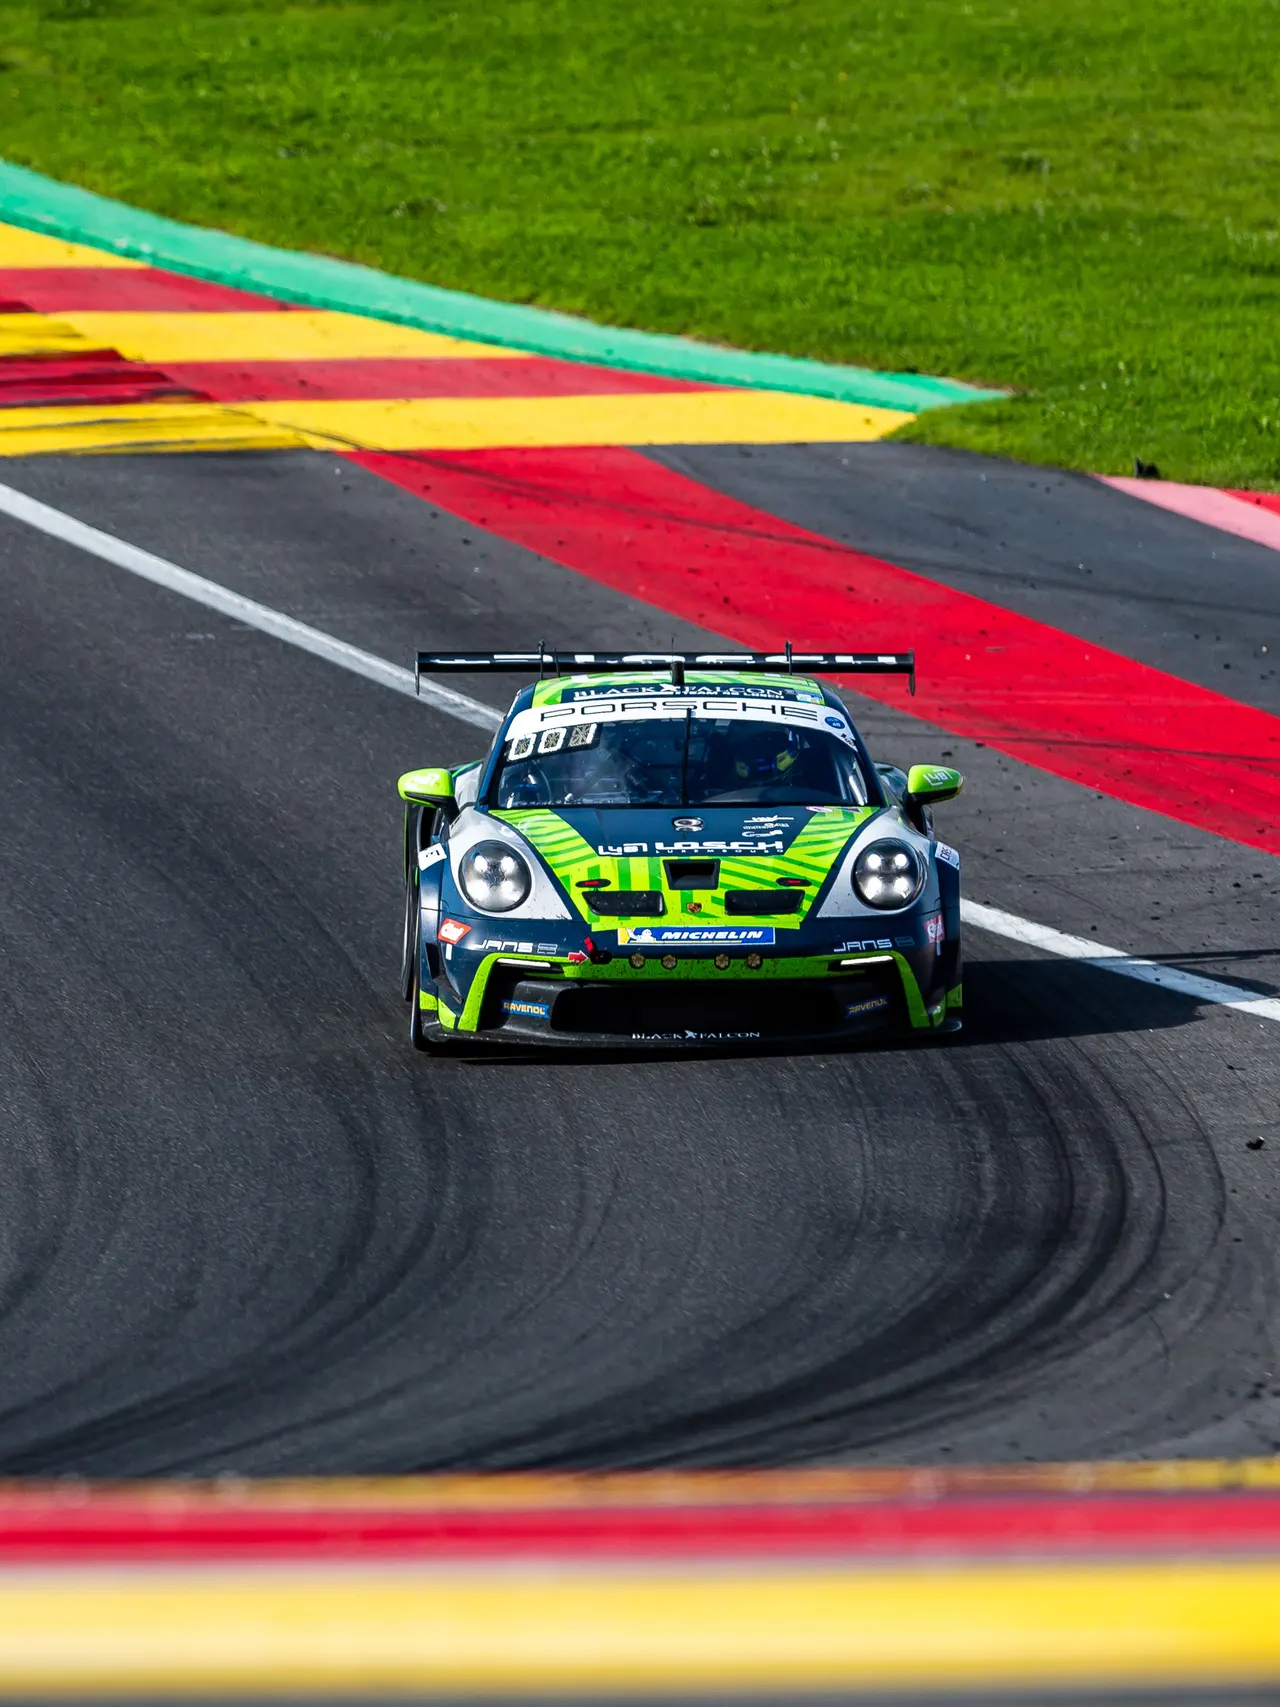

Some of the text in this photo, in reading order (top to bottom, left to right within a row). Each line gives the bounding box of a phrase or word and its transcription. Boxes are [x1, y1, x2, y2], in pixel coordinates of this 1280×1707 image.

[574, 685, 784, 698] BLACK FALCON
[540, 700, 818, 722] PORSCHE
[655, 841, 784, 850] LOSCH
[661, 930, 764, 940] MICHELIN
[833, 938, 893, 953] JANS
[503, 1001, 546, 1016] RAVENOL
[699, 1031, 761, 1039] FALCON
